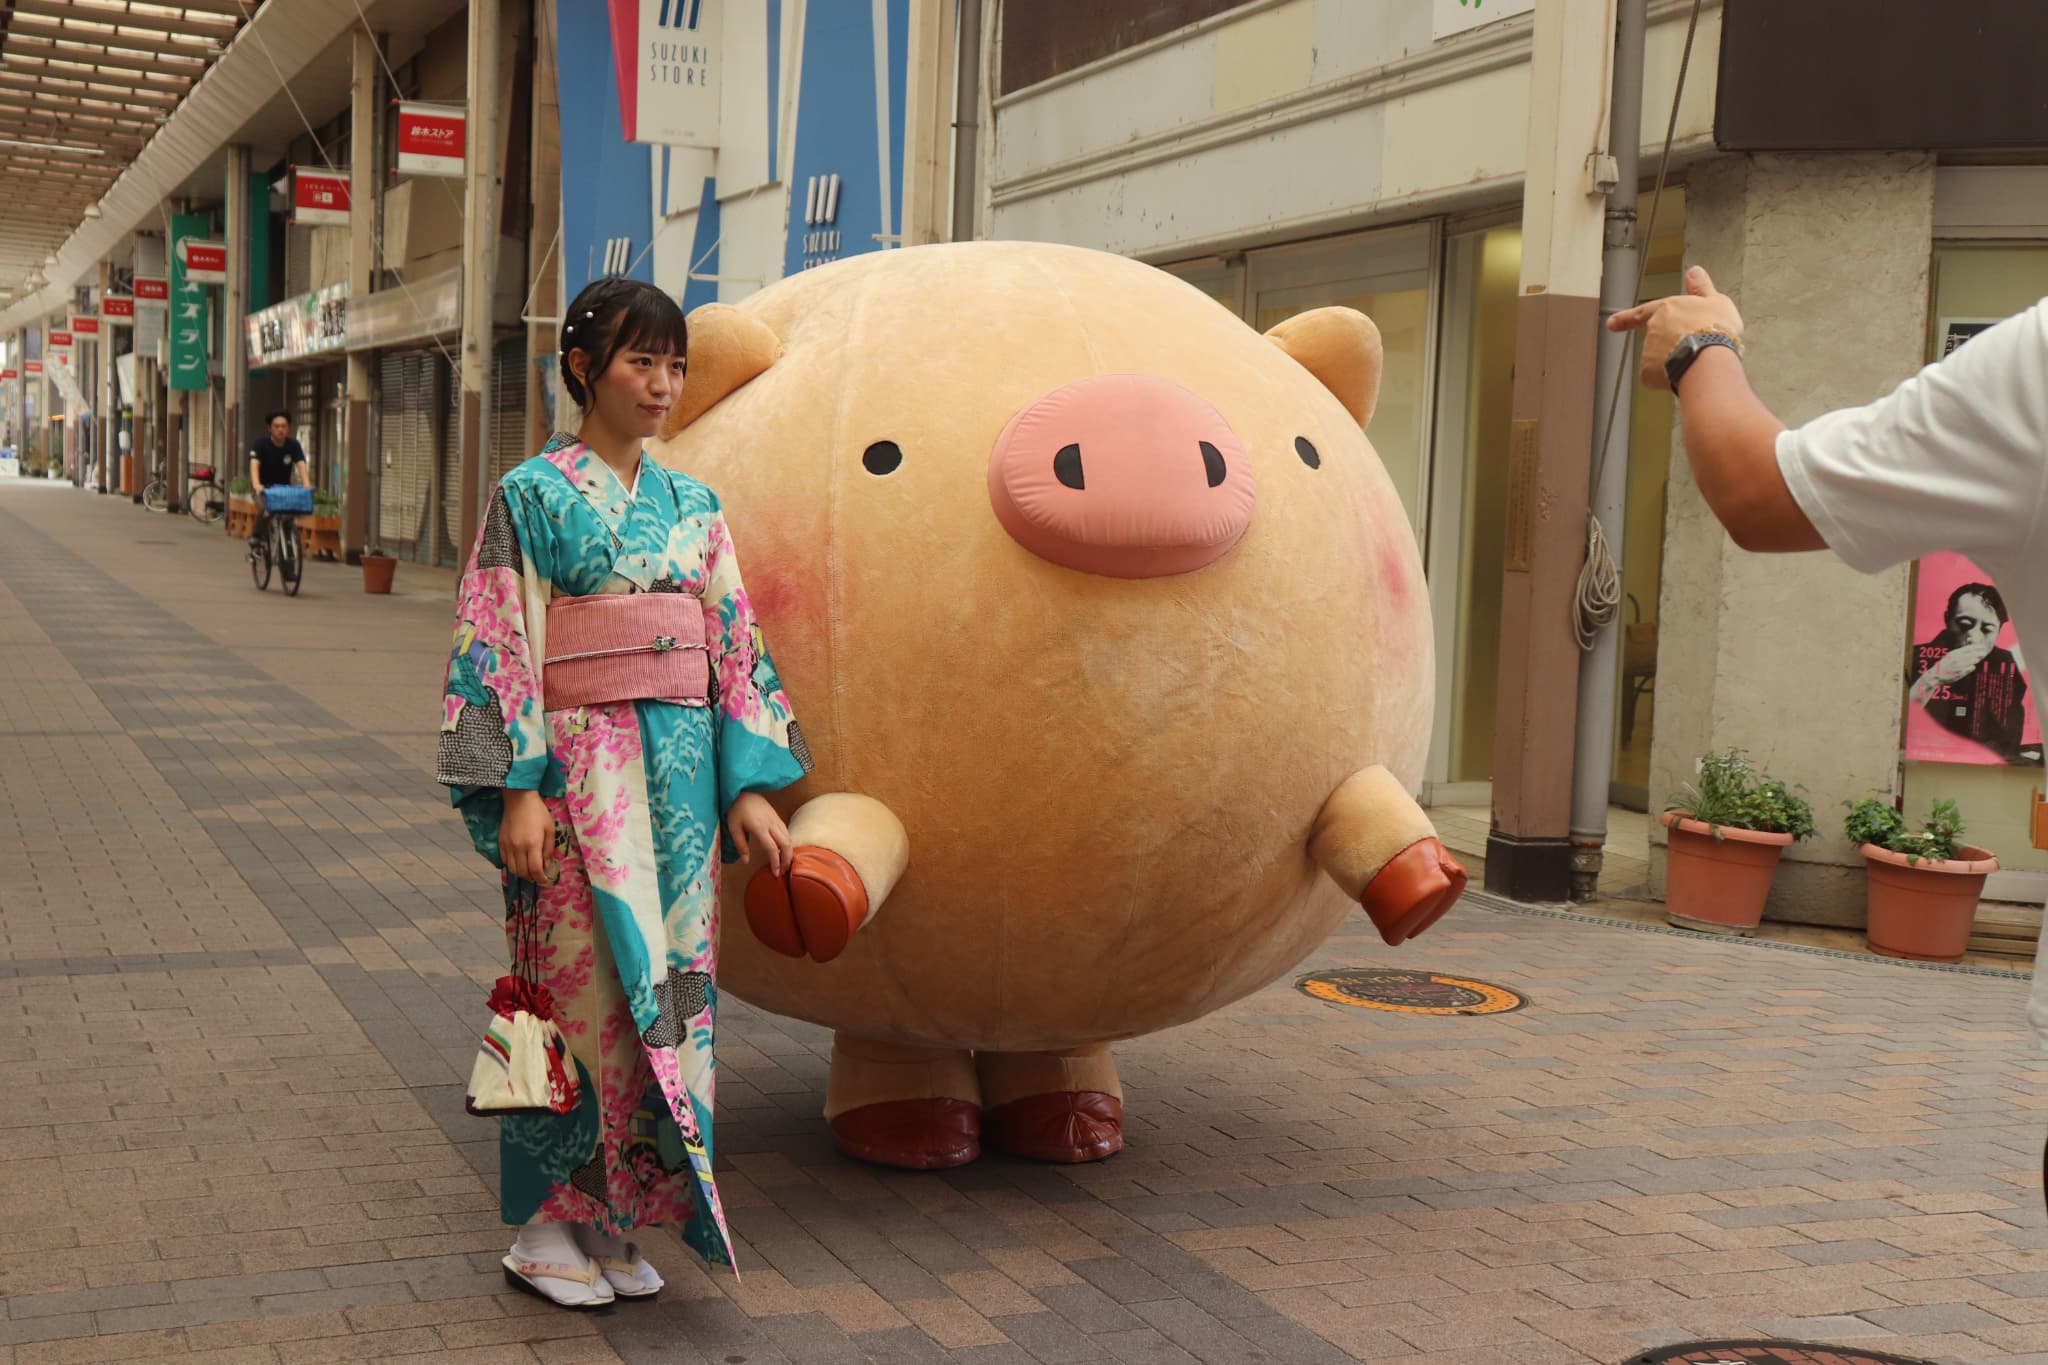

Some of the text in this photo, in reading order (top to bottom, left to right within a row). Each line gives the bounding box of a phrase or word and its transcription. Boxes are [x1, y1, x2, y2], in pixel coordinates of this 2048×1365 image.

[651, 41, 707, 65] SUZUKI
[651, 64, 705, 87] STORE
[803, 231, 840, 255] SUZUKI
[1919, 647, 1949, 659] 2025
